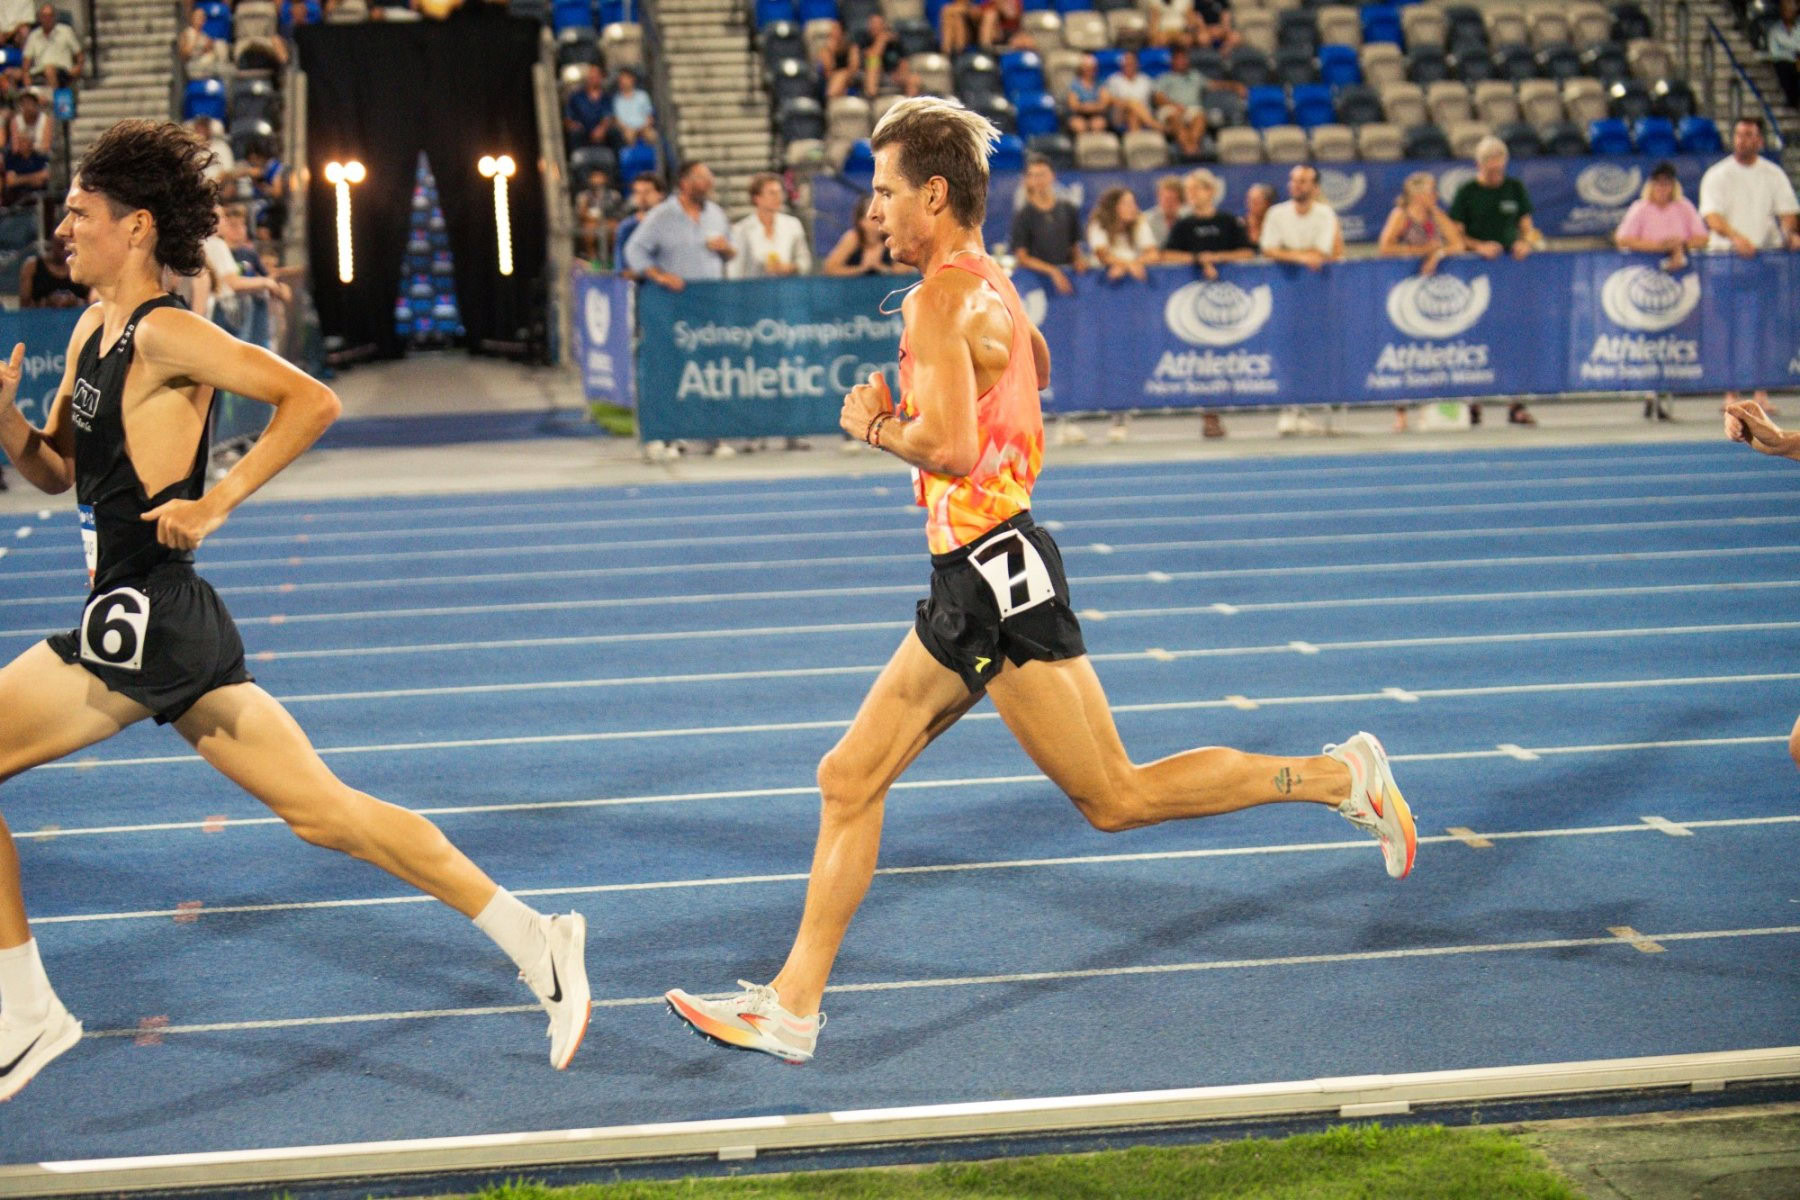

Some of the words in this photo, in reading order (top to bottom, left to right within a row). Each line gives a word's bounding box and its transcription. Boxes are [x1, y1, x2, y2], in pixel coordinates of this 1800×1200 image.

[1153, 348, 1273, 379] Athletics
[1376, 340, 1489, 370] Athletics
[1589, 332, 1698, 362] Athletics
[677, 356, 825, 400] Athletic
[974, 533, 1031, 609] 7
[86, 592, 142, 664] 6
